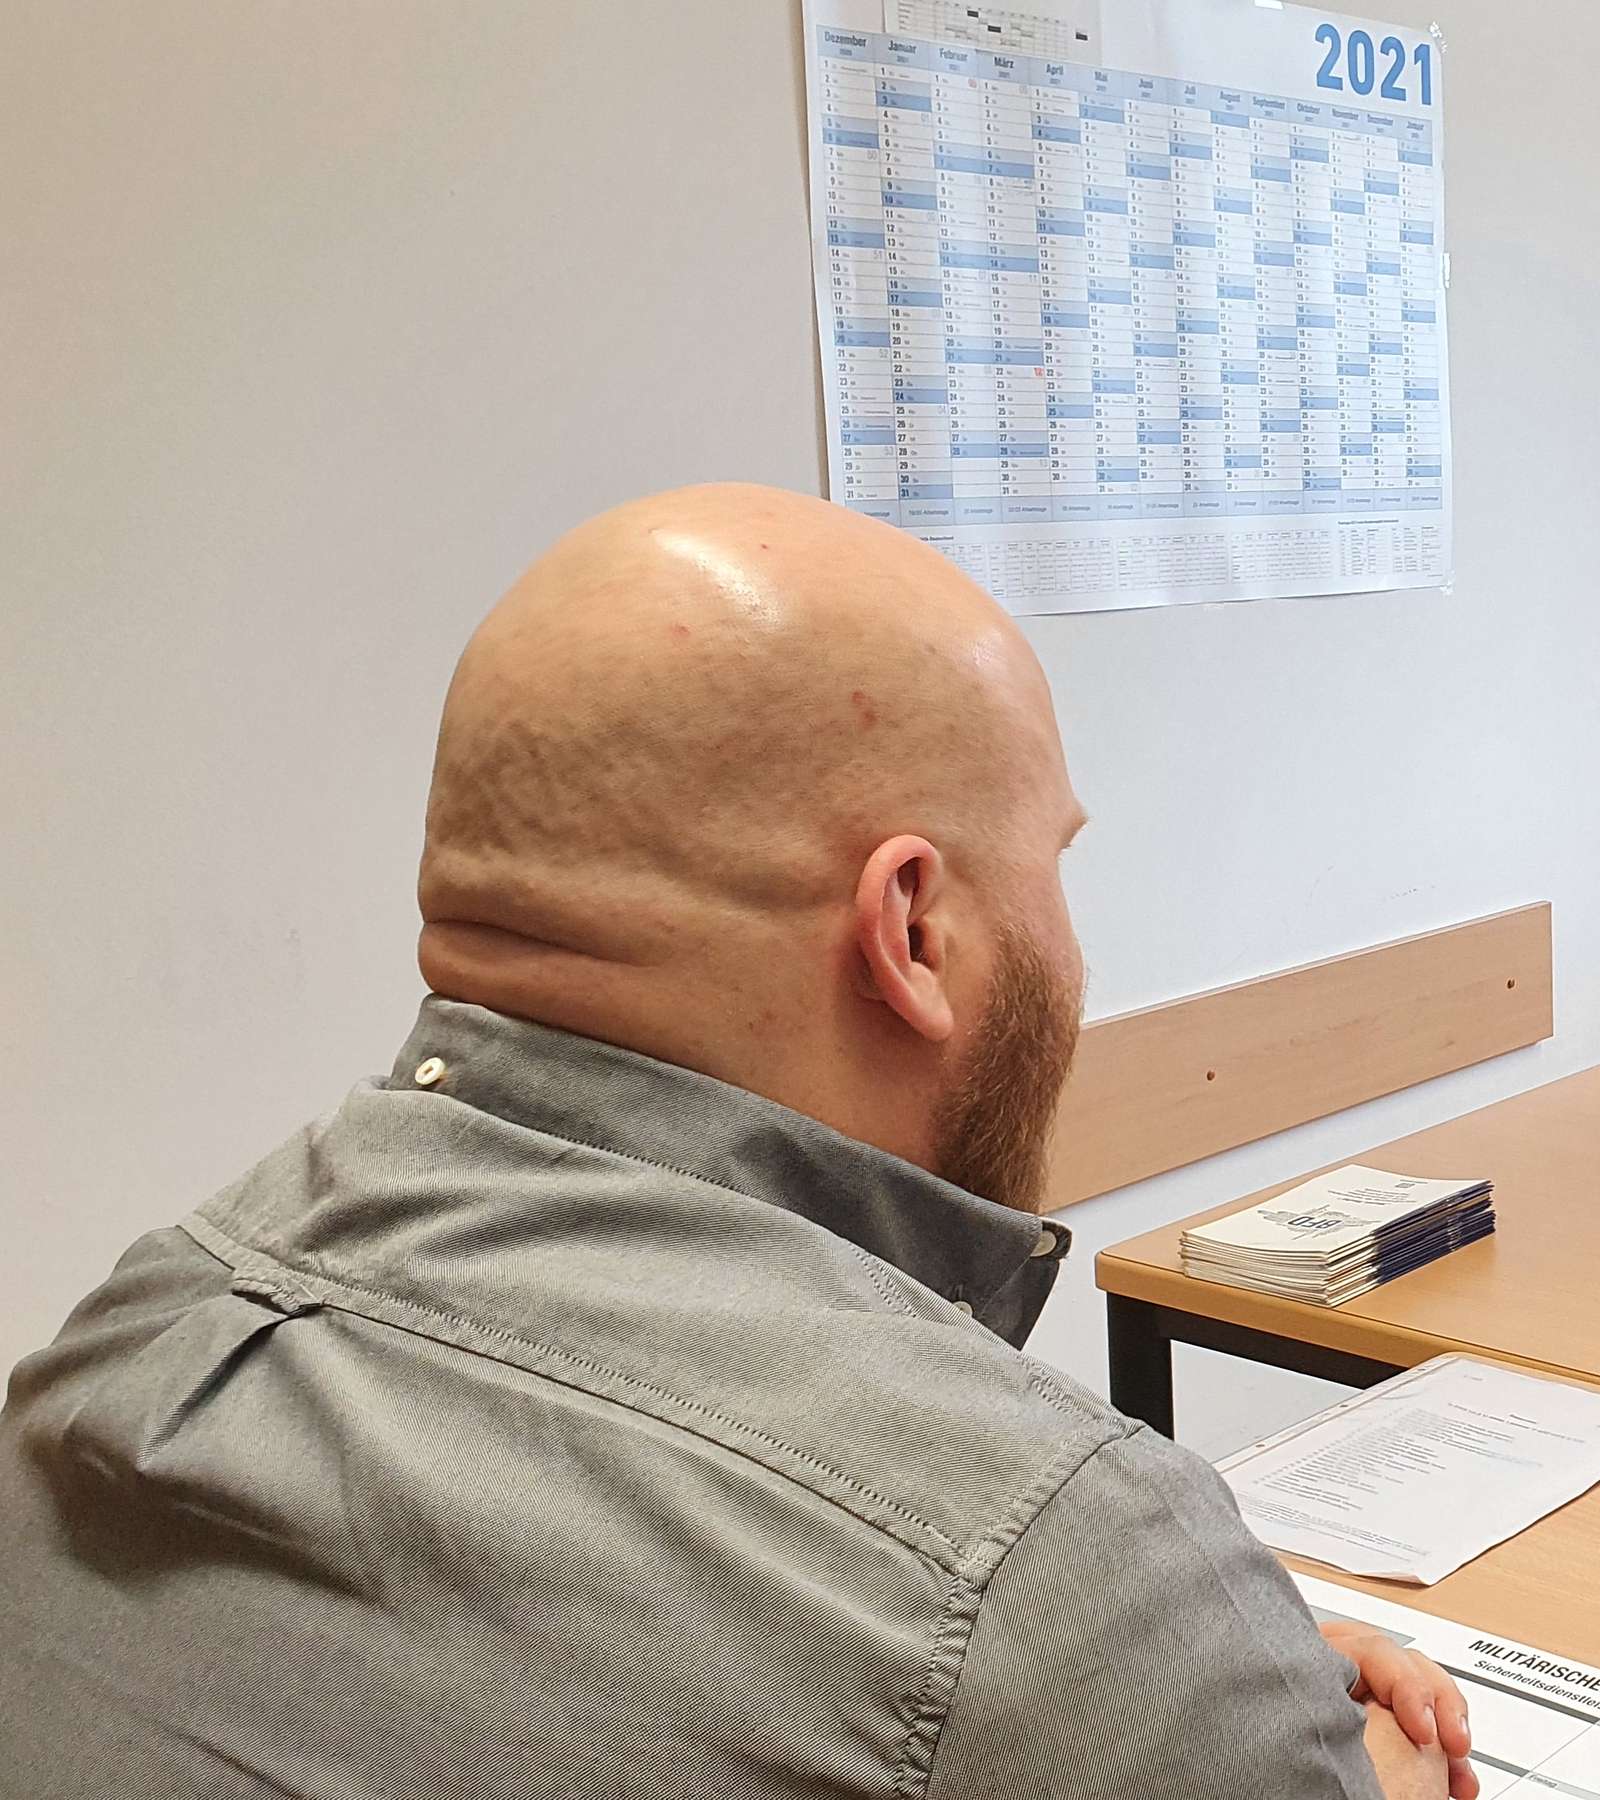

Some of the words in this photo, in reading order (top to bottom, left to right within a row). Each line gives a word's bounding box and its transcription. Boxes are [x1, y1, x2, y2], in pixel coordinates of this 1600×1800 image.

[824, 31, 867, 48] Dezember
[888, 39, 917, 54] Januar
[939, 47, 969, 62] Februar
[993, 56, 1014, 69] März
[1315, 23, 1432, 106] 2021
[881, 67, 886, 76] 1
[1046, 63, 1064, 76] April
[1094, 71, 1108, 82] Mai
[881, 81, 887, 90] 2
[882, 95, 888, 104] 3
[1220, 90, 1241, 103] August
[883, 110, 888, 119] 4
[883, 124, 889, 133] 5
[884, 138, 890, 147] 6
[885, 153, 891, 162] 7
[886, 167, 892, 176] 8
[887, 181, 893, 190] 9
[884, 195, 893, 204] 10
[885, 209, 894, 219] 11
[886, 224, 895, 233] 12
[886, 238, 896, 247] 13
[887, 252, 897, 261] 14
[888, 266, 897, 275] 15
[889, 280, 898, 289] 16
[890, 294, 899, 303] 17
[891, 308, 900, 317] 18
[891, 322, 901, 331] 19
[892, 336, 901, 345] 20
[893, 350, 902, 359] 21
[894, 364, 903, 373] 22
[895, 378, 904, 387] 23
[895, 392, 905, 401] 24
[896, 406, 905, 415] 25
[897, 419, 906, 429] 26
[898, 433, 907, 442] 27
[898, 447, 908, 456] 28
[899, 461, 909, 470] 29
[900, 475, 909, 484] 30
[901, 488, 910, 498] 31
[1287, 1216, 1341, 1230] BFD
[1527, 1773, 1558, 1789] Freitag
